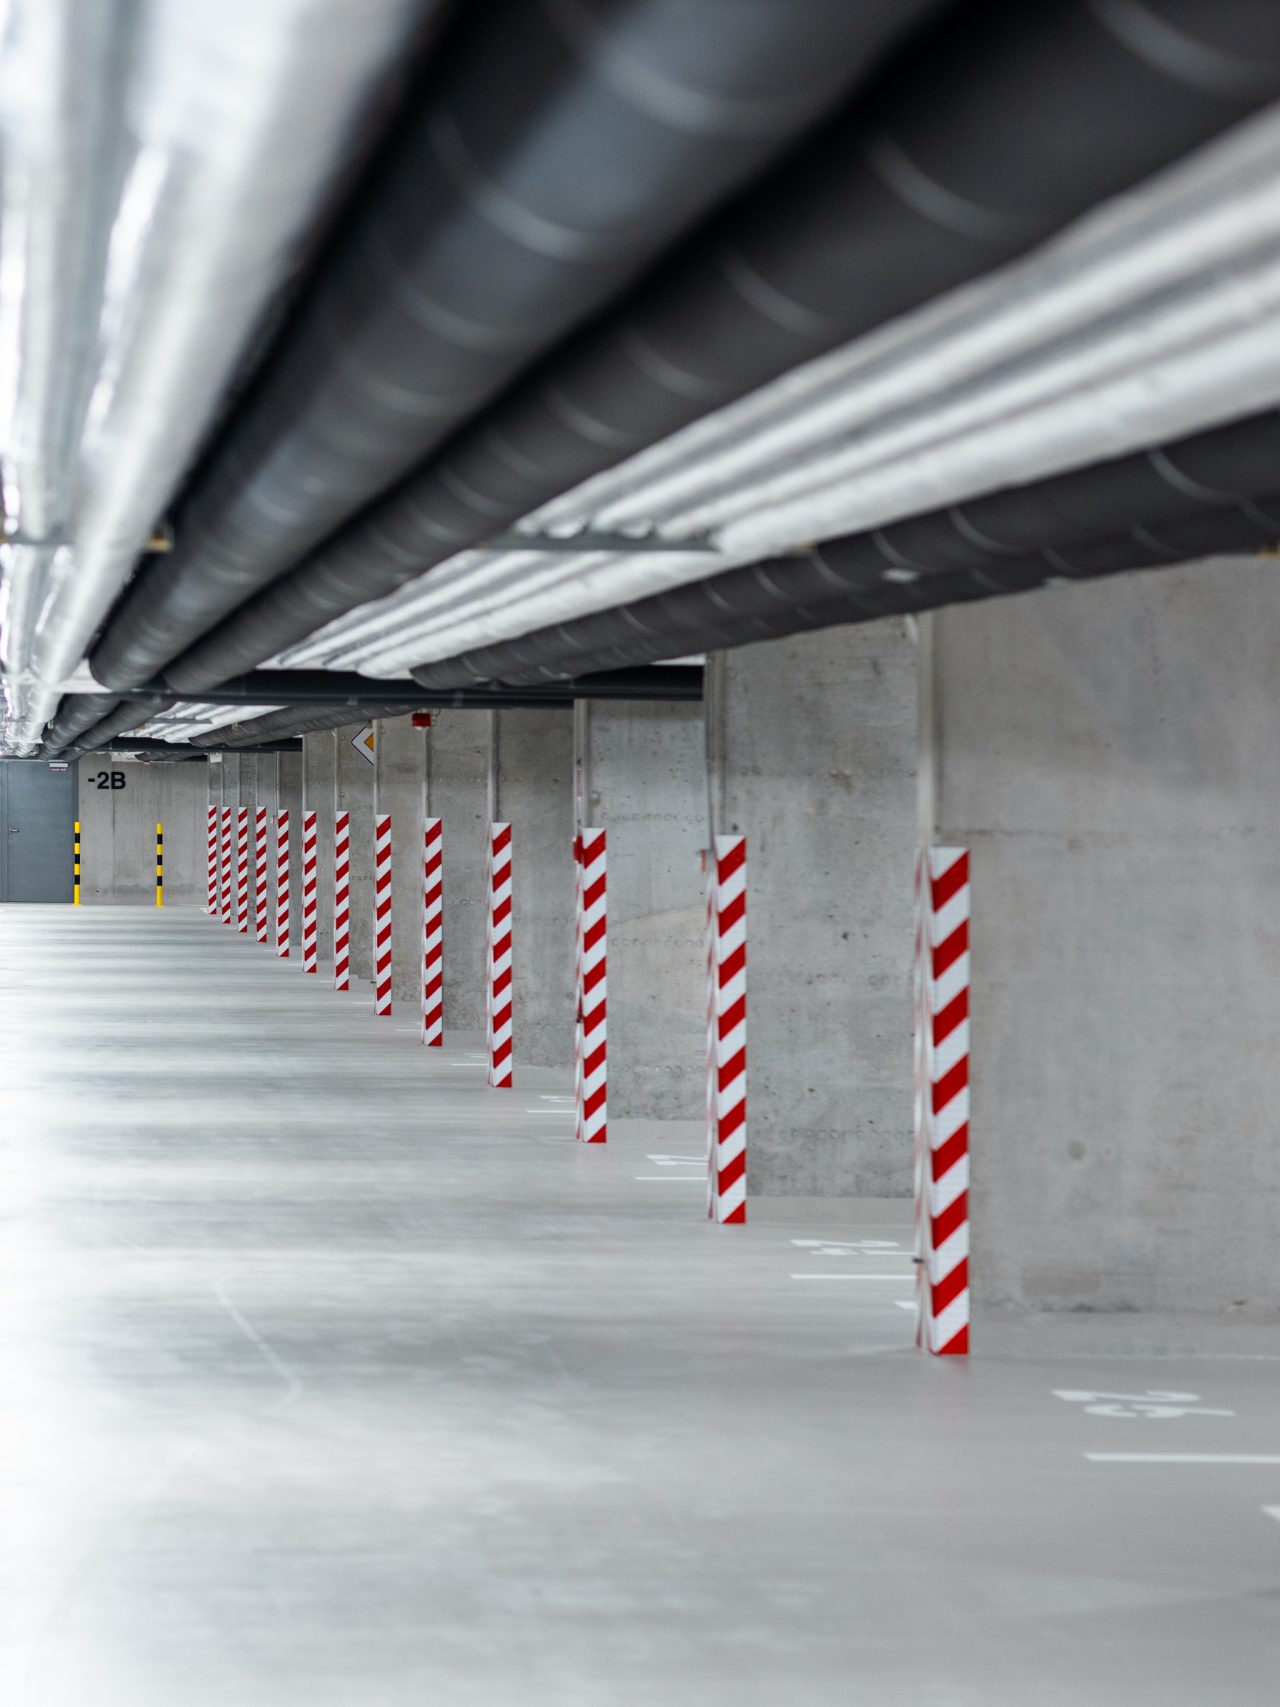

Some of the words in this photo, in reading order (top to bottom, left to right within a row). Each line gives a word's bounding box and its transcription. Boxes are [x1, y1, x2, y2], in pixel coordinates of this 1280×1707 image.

[88, 771, 126, 790] -2B
[790, 1239, 919, 1256] 24
[1050, 1389, 1236, 1418] 26
